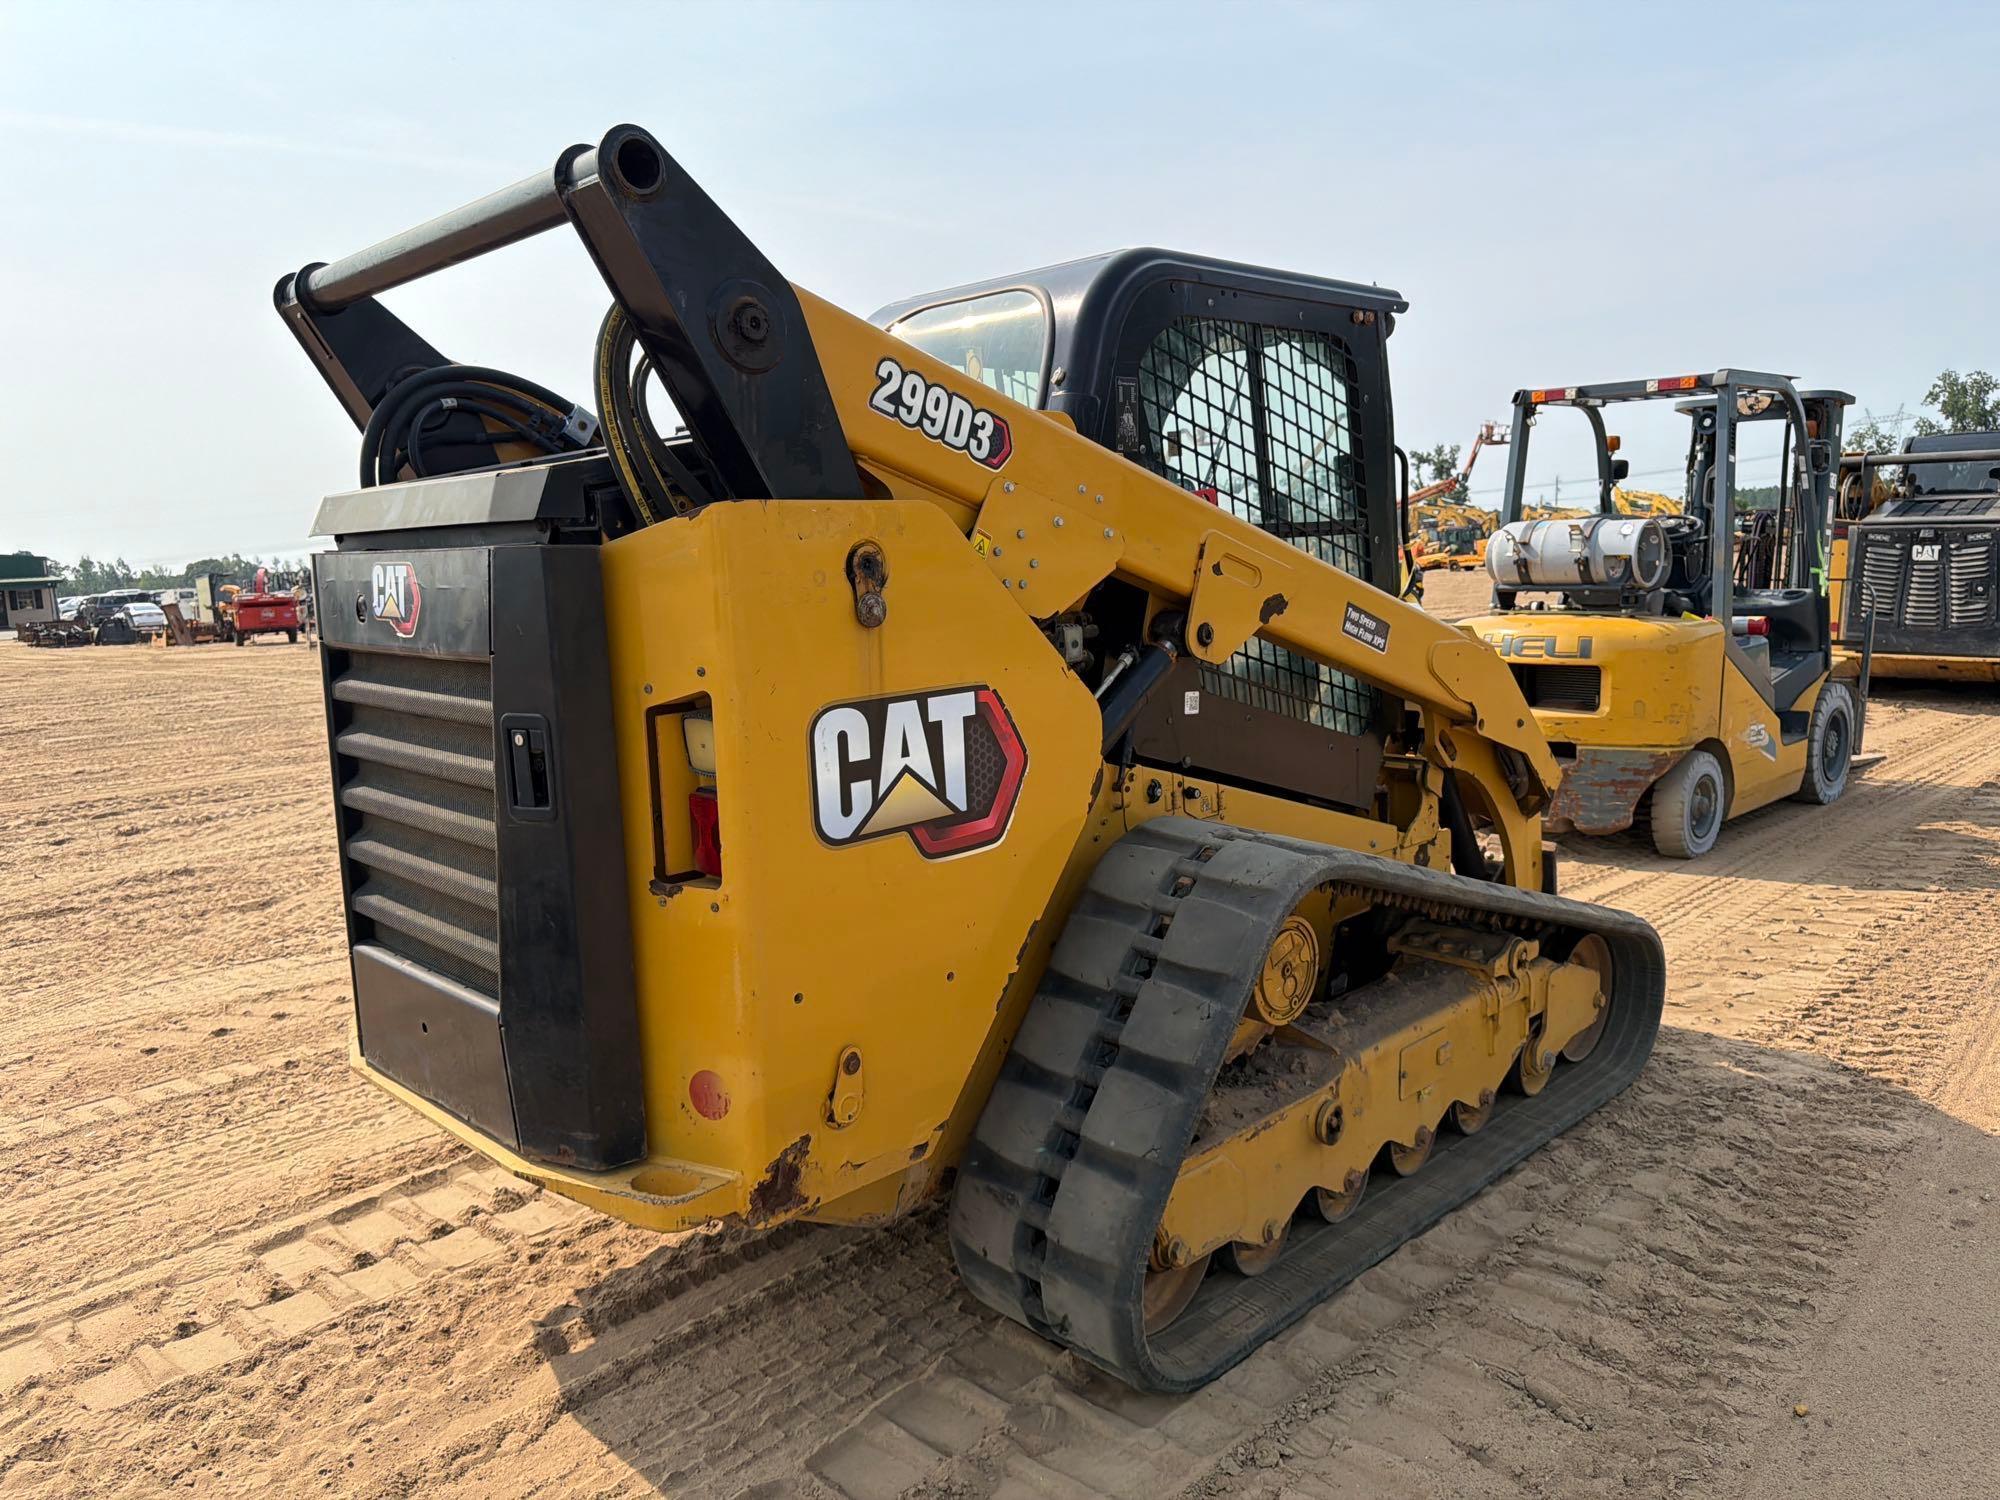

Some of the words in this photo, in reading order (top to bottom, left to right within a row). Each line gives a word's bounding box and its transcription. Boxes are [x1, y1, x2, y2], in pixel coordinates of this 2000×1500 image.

[872, 359, 994, 460] 299D3
[1912, 544, 1941, 561] CAT
[373, 564, 407, 618] CAT
[1372, 634, 1386, 649] XPS
[814, 691, 976, 840] CAT
